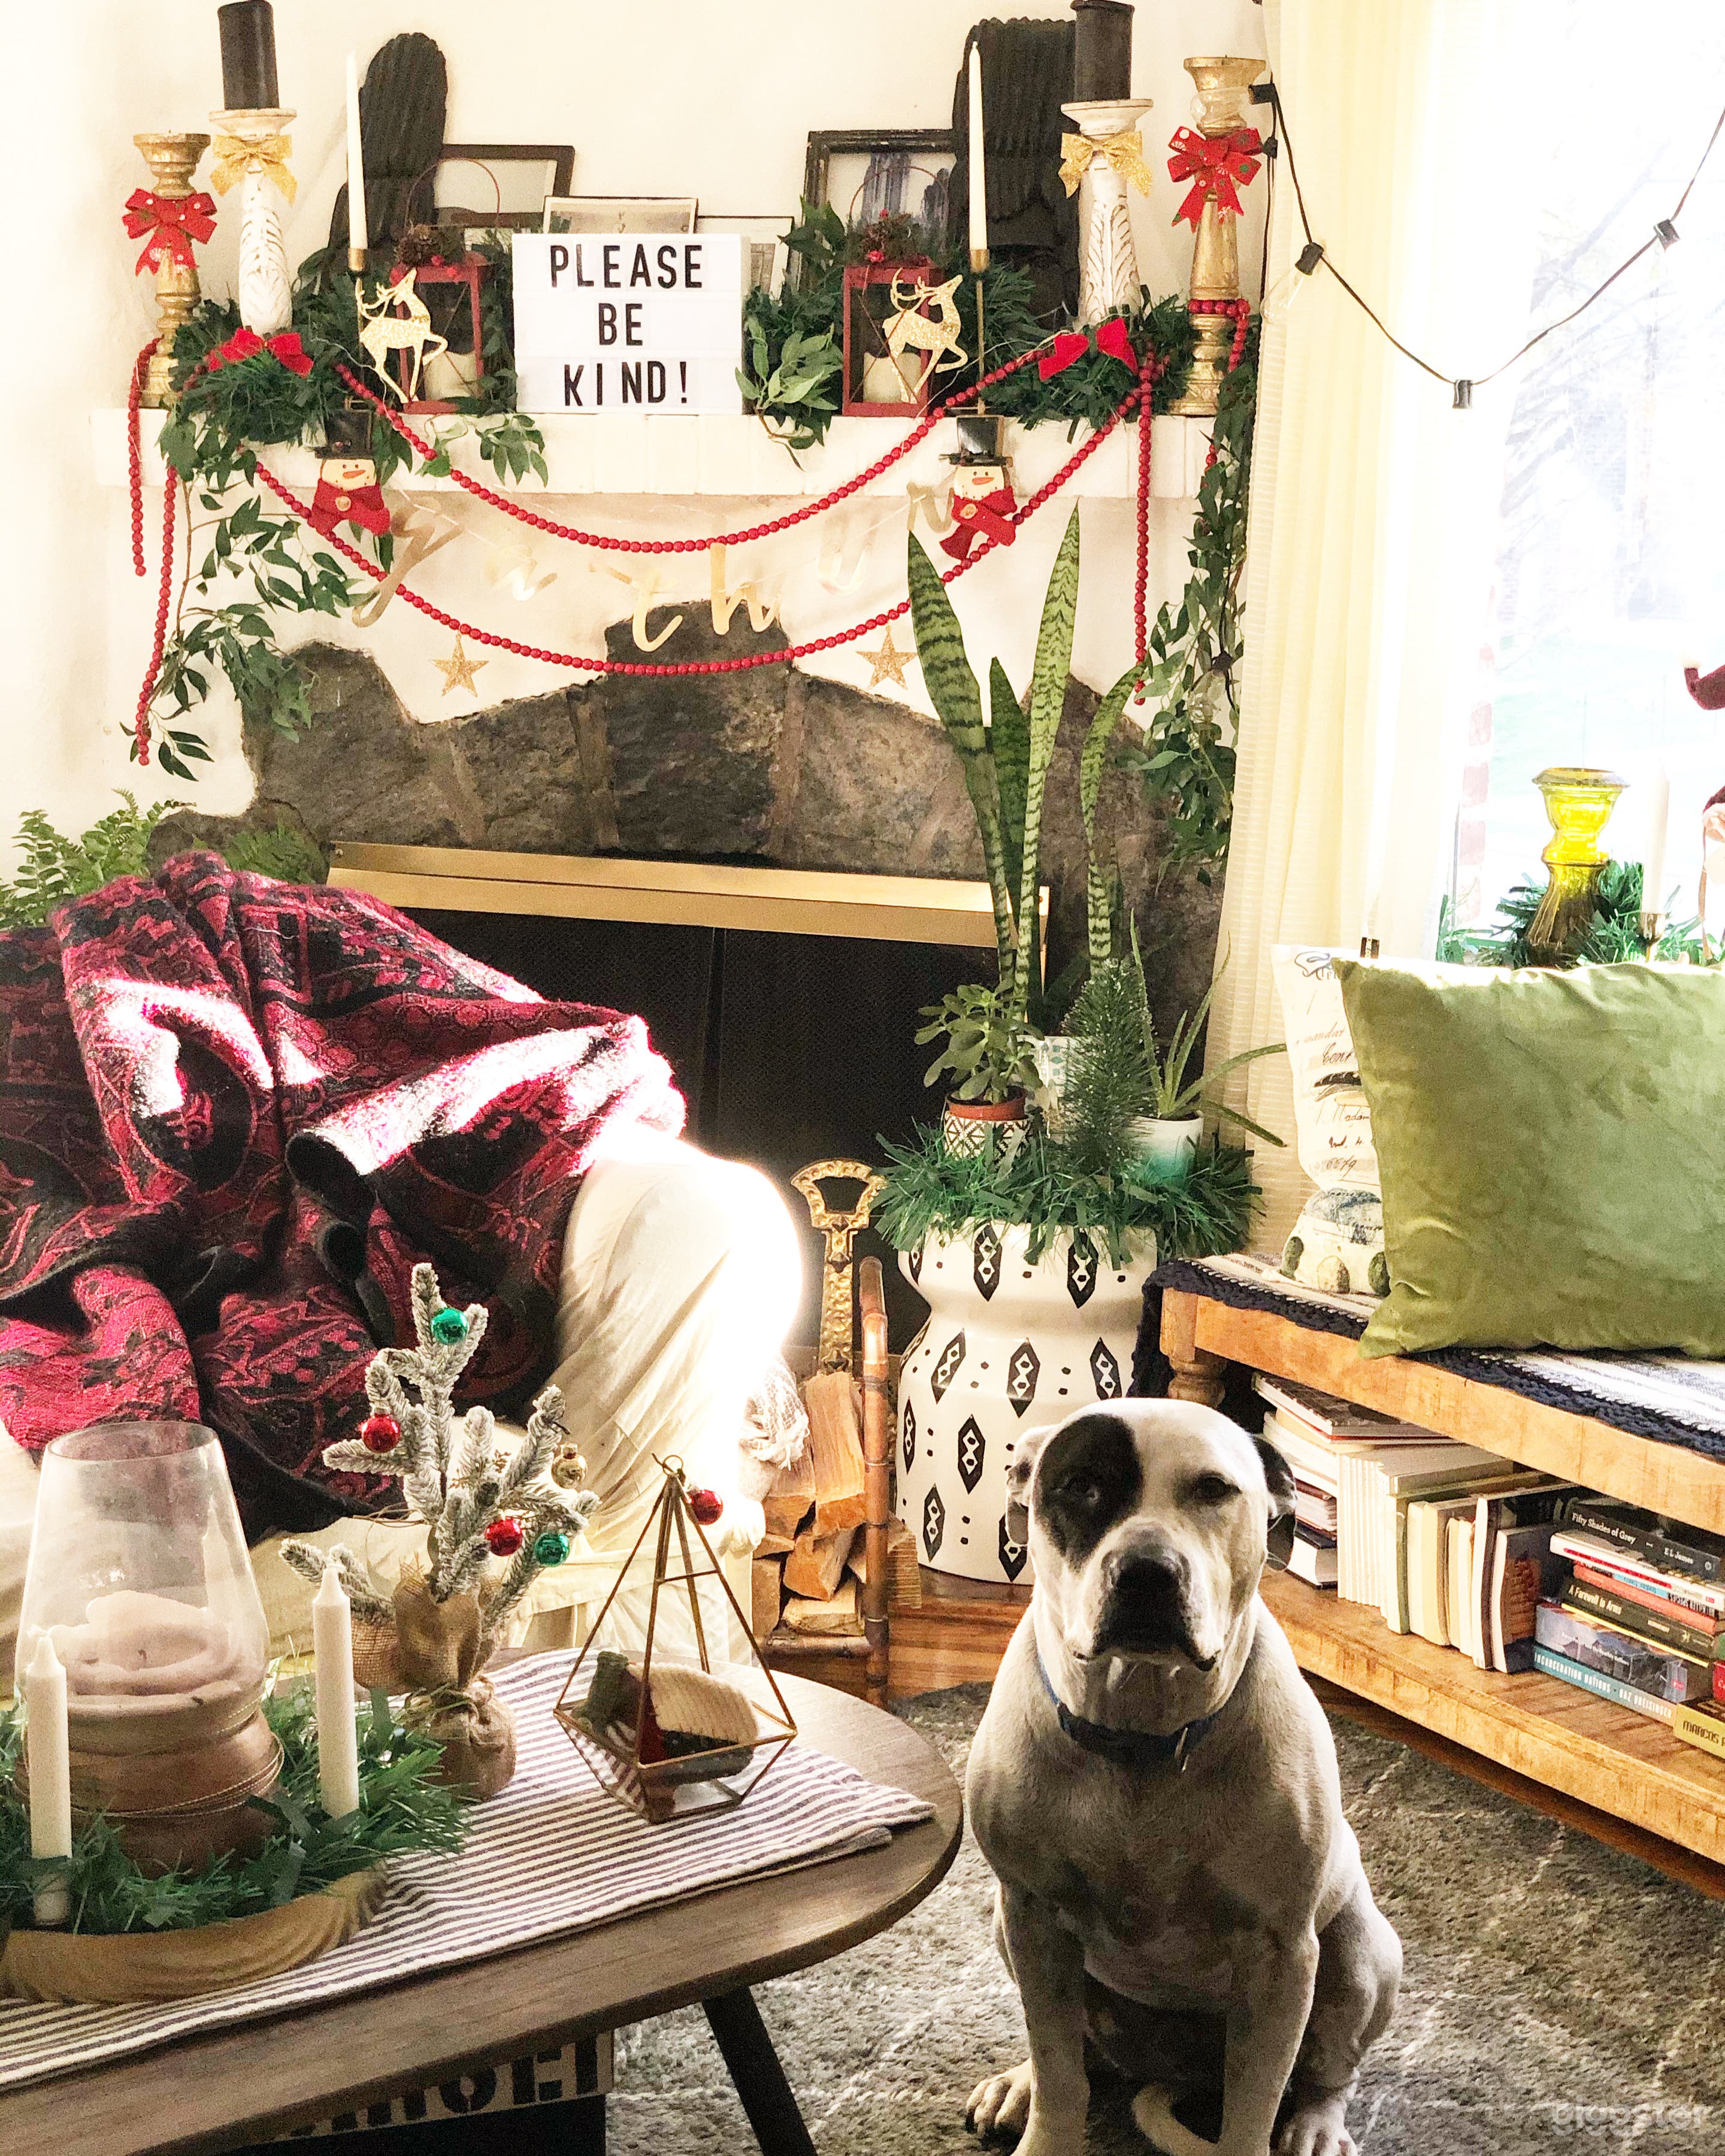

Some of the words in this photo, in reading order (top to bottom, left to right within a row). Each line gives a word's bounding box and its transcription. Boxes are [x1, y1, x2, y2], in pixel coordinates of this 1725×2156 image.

[550, 244, 702, 289] PLEASE
[598, 302, 643, 346] BE
[564, 361, 687, 407] KIND!
[1572, 1513, 1587, 1527] Fifty
[1588, 1518, 1611, 1534] Shades
[1611, 1528, 1619, 1537] of
[1619, 1530, 1636, 1545] Grey
[1674, 1552, 1694, 1565] James
[1569, 1584, 1574, 1595] A
[1575, 1587, 1600, 1606] Farewell
[1600, 1597, 1606, 1608] to
[1606, 1600, 1622, 1615] Arms
[1534, 1652, 1582, 1681] INCARCERATION
[1584, 1674, 1611, 1694] NATIONS
[1683, 1720, 1720, 1744] MARCOS
